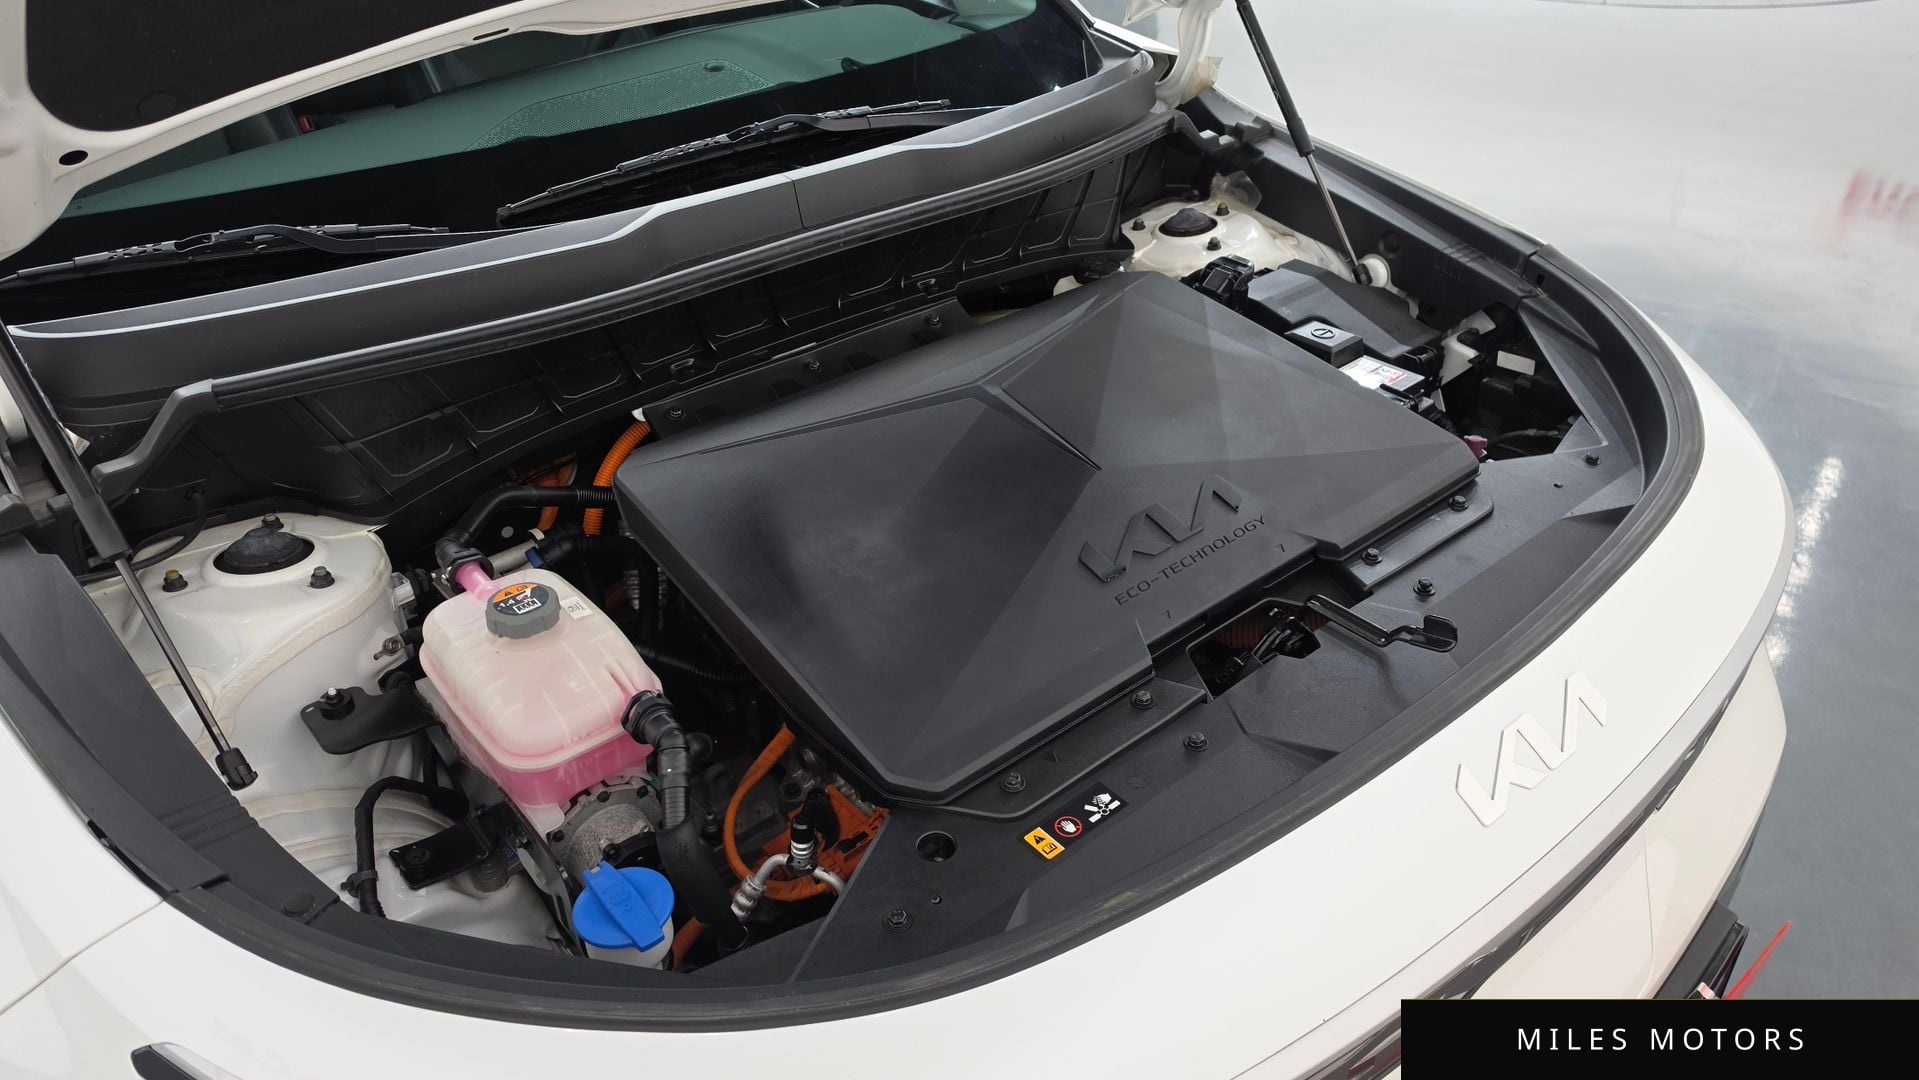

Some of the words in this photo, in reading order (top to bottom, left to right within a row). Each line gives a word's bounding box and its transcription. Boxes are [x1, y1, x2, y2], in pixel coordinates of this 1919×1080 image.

[1078, 474, 1242, 583] KIA
[1113, 514, 1266, 606] ECO-TECHNOLOGY
[1455, 671, 1608, 828] KIA
